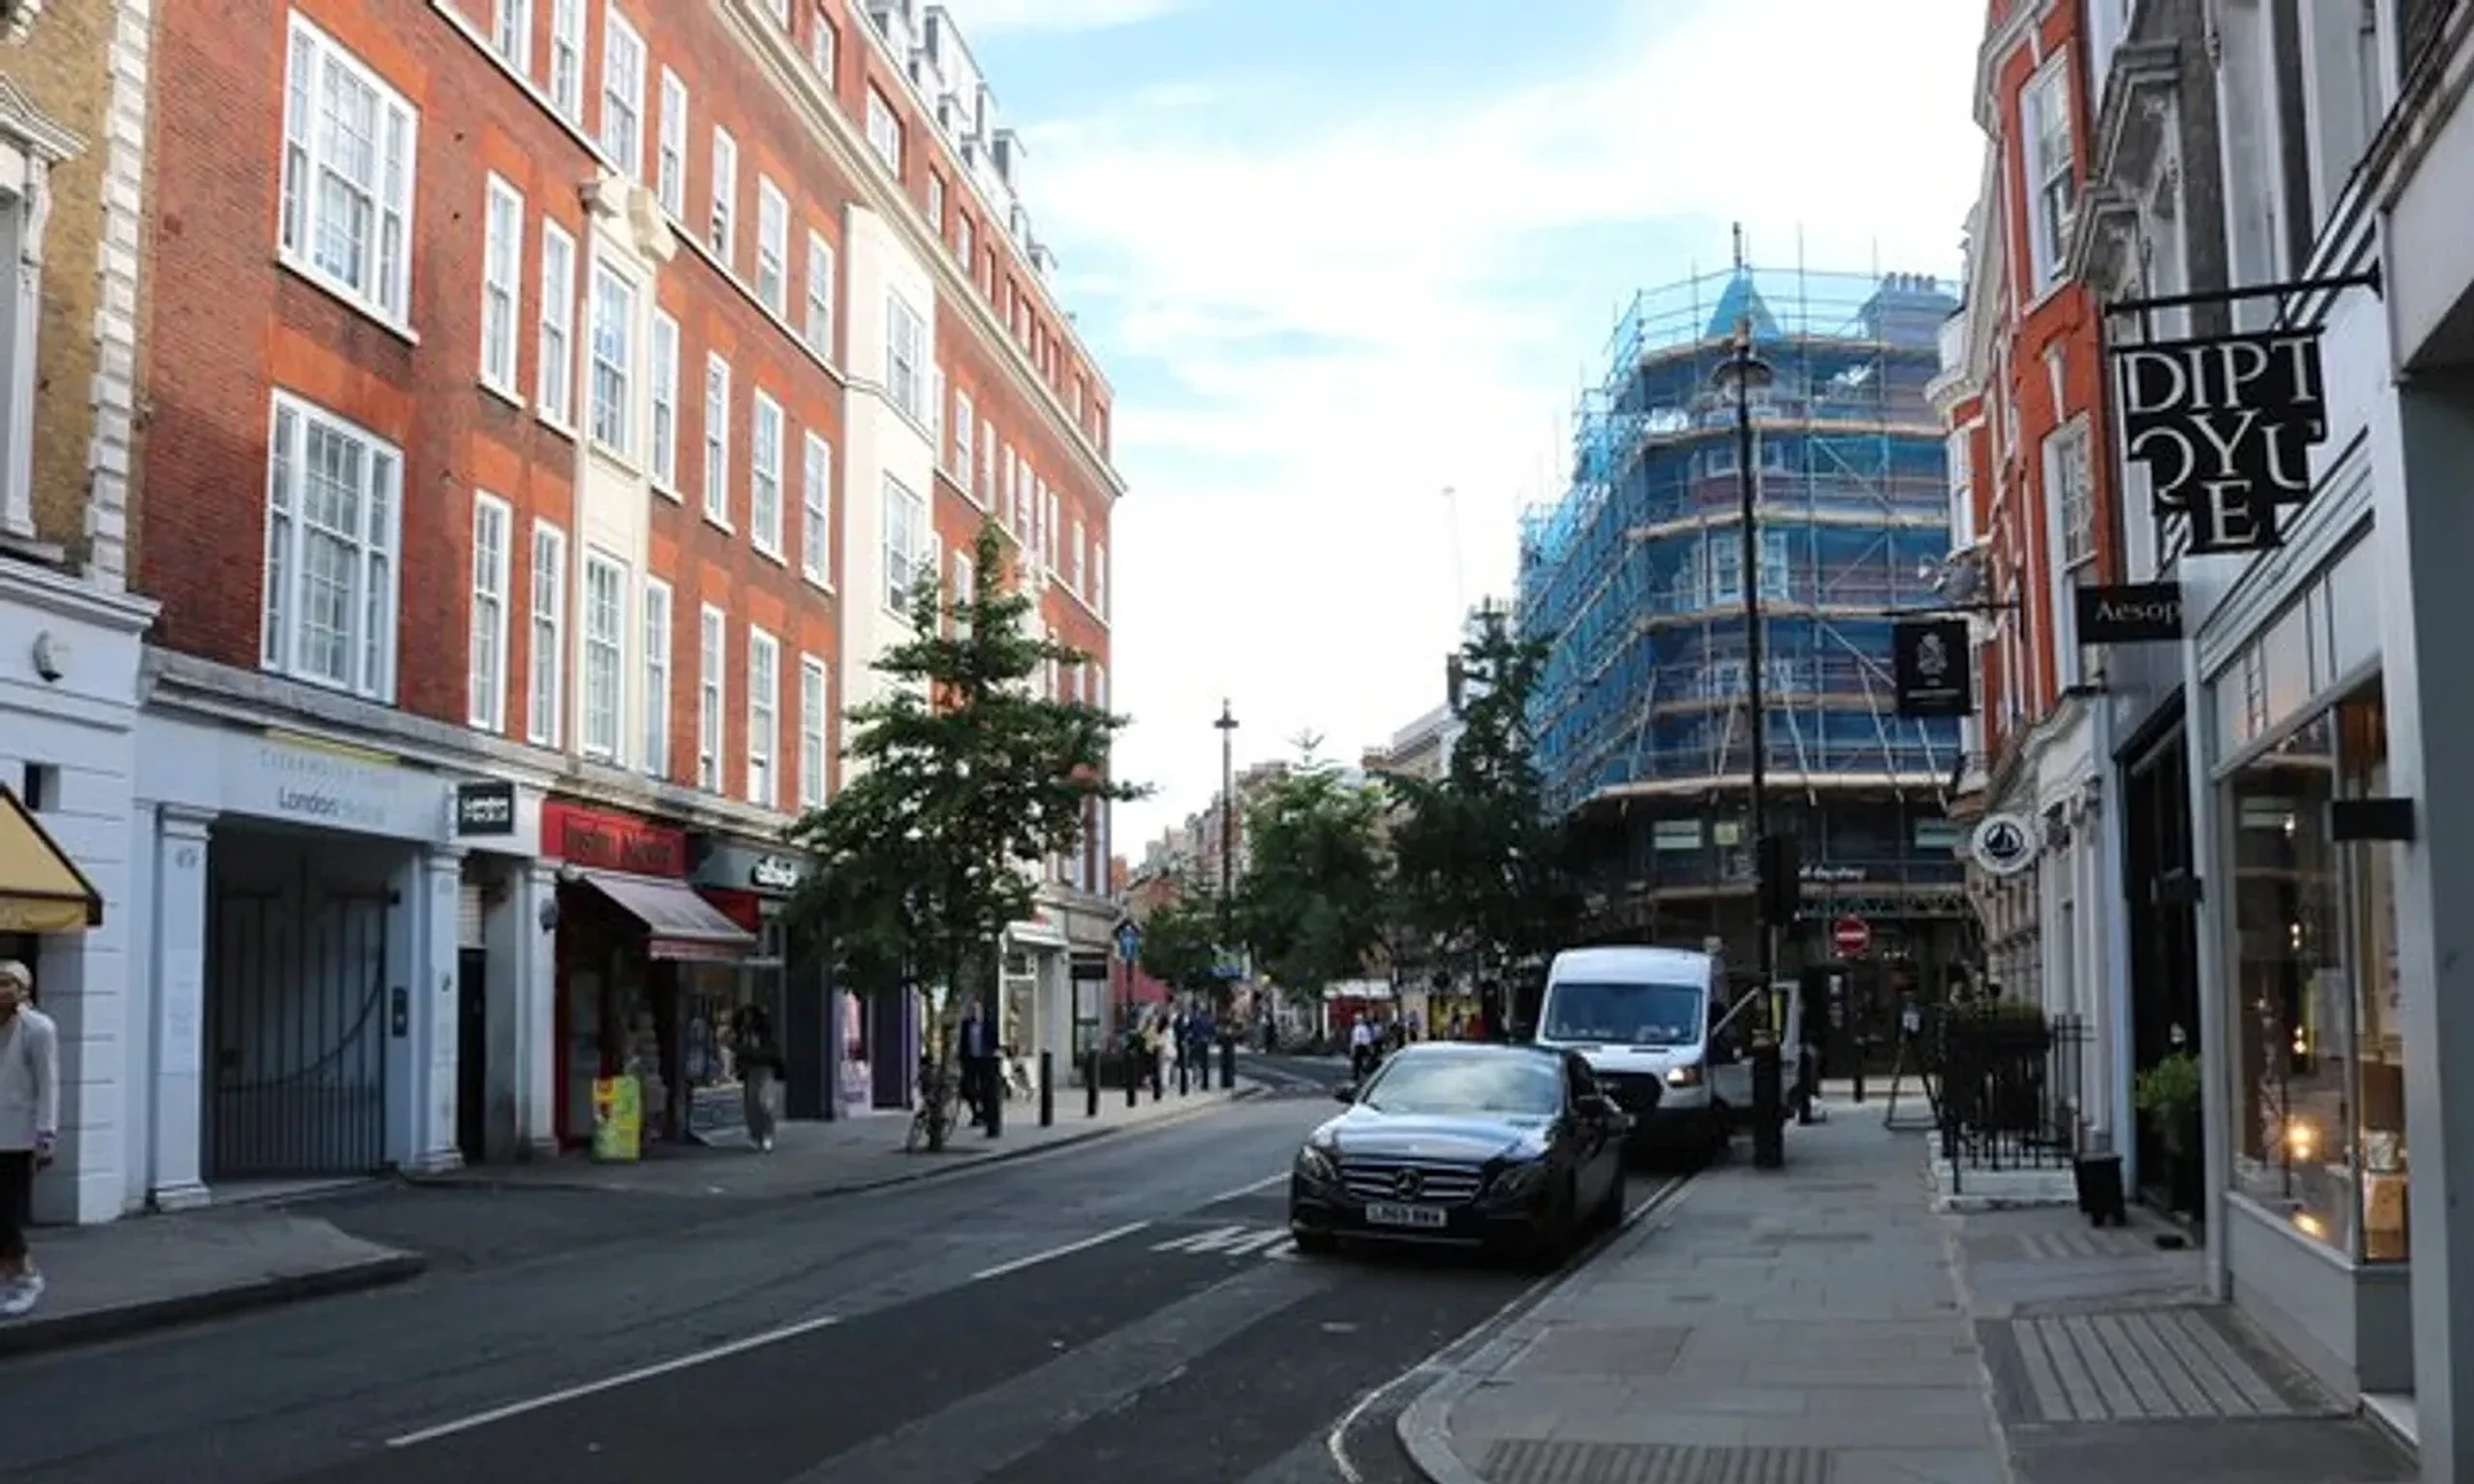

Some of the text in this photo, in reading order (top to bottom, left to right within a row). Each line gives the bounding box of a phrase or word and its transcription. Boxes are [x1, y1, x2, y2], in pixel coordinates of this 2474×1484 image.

[2123, 337, 2318, 414] DIPT
[2201, 479, 2260, 545] E
[2095, 599, 2182, 627] Aesop
